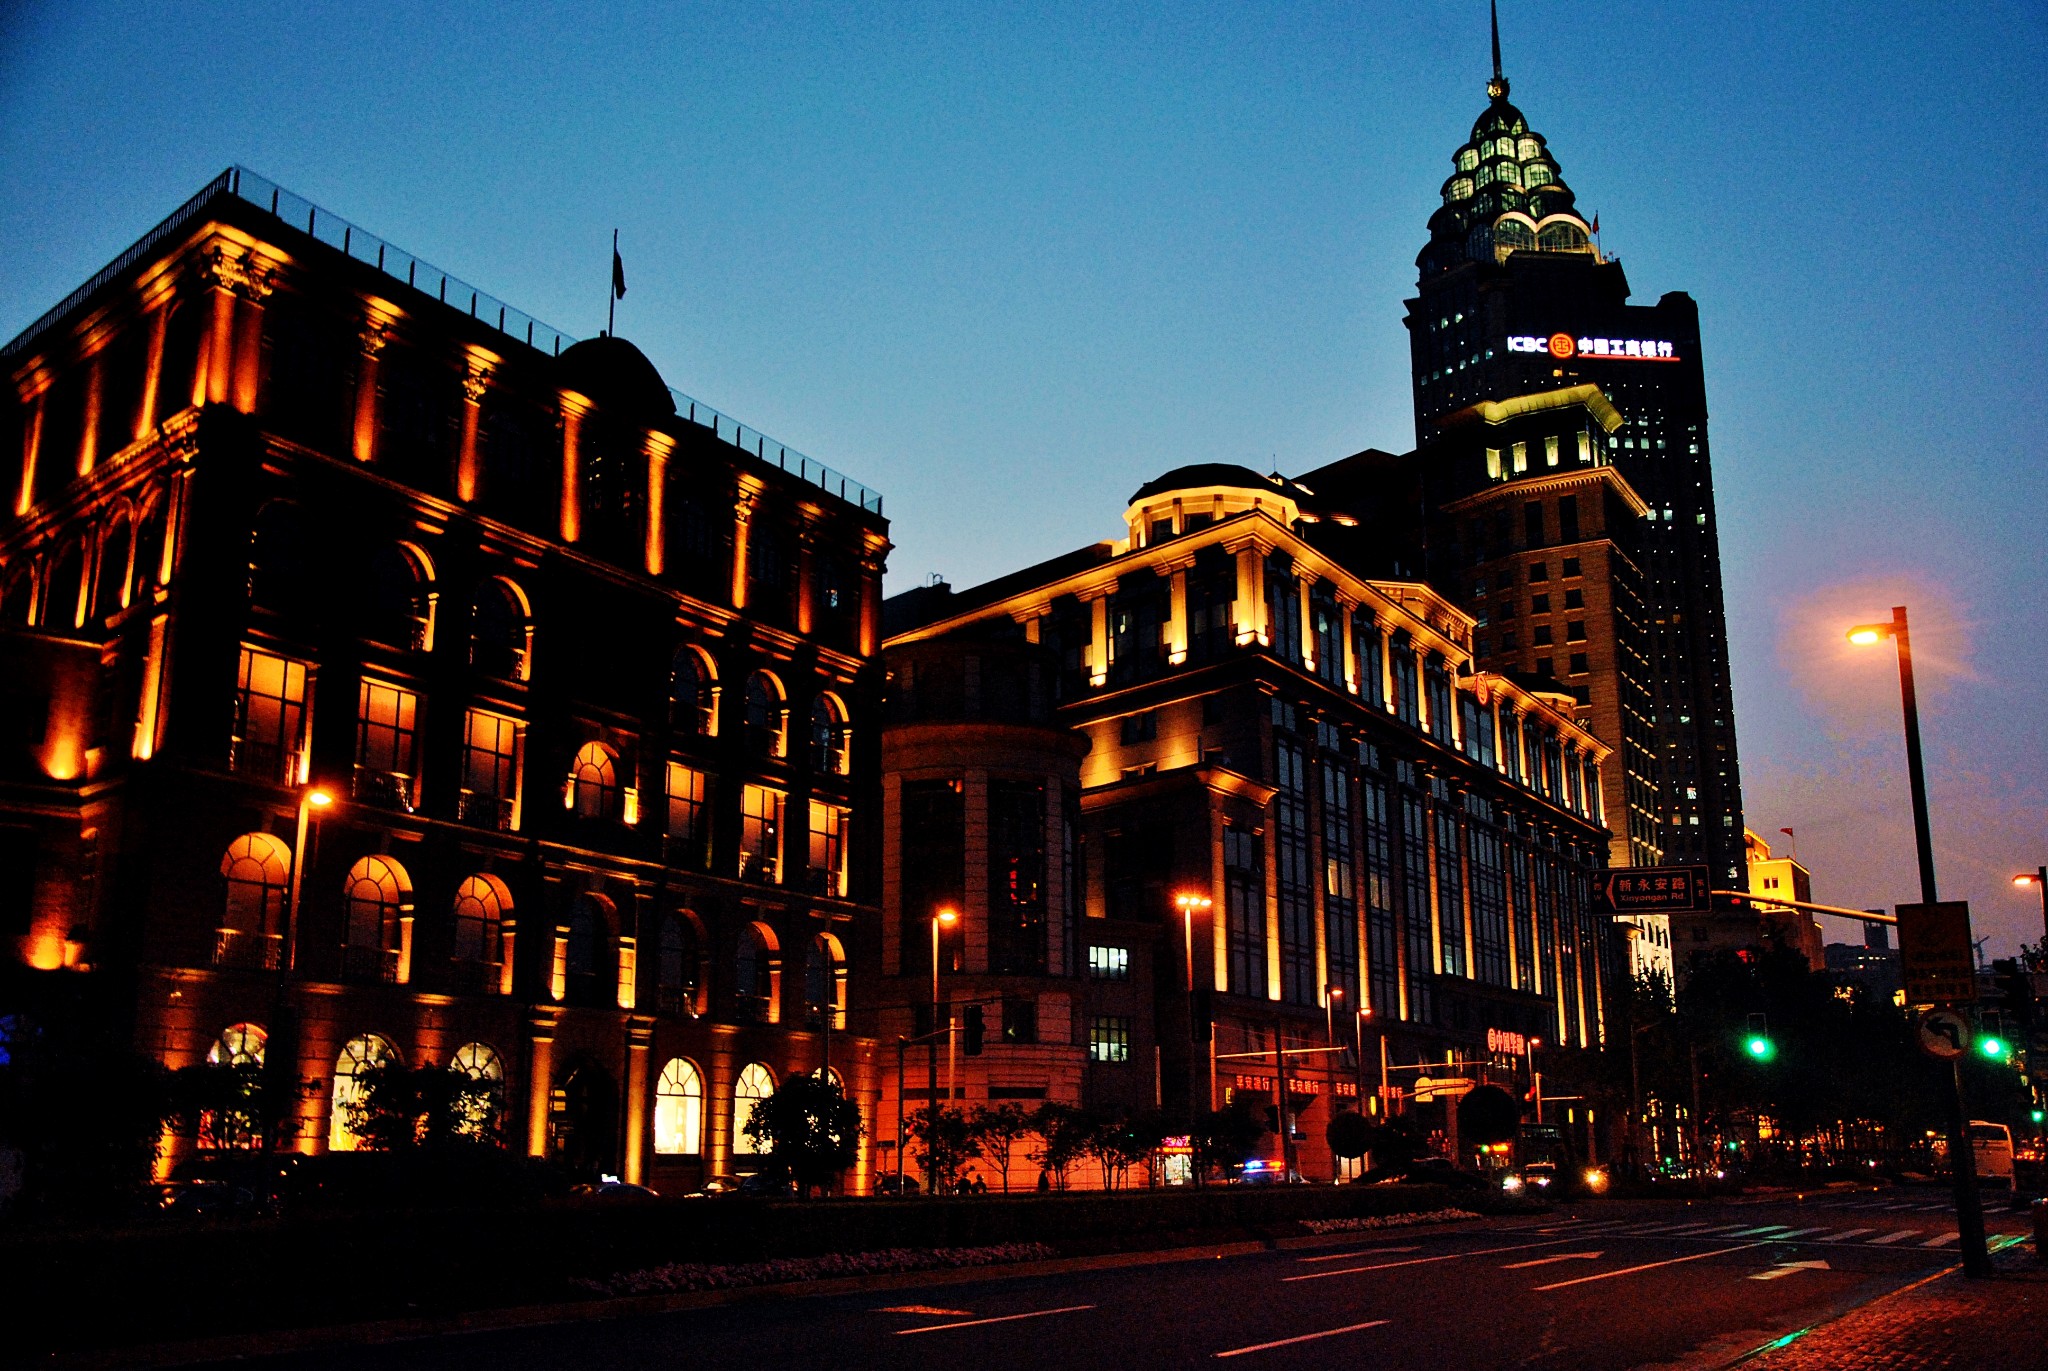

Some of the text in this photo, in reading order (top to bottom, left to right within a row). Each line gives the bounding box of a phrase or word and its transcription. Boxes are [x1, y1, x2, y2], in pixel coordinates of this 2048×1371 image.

[1507, 336, 1548, 353] ICBC
[1577, 337, 1673, 358] 中国工商银行
[1619, 877, 1686, 892] 新永安路
[1593, 894, 1602, 902] W
[1620, 894, 1668, 903] Xinyongan
[1236, 1075, 1270, 1091] 平安银行
[1289, 1079, 1319, 1095] 平安银行
[1336, 1083, 1358, 1097] 平安银
